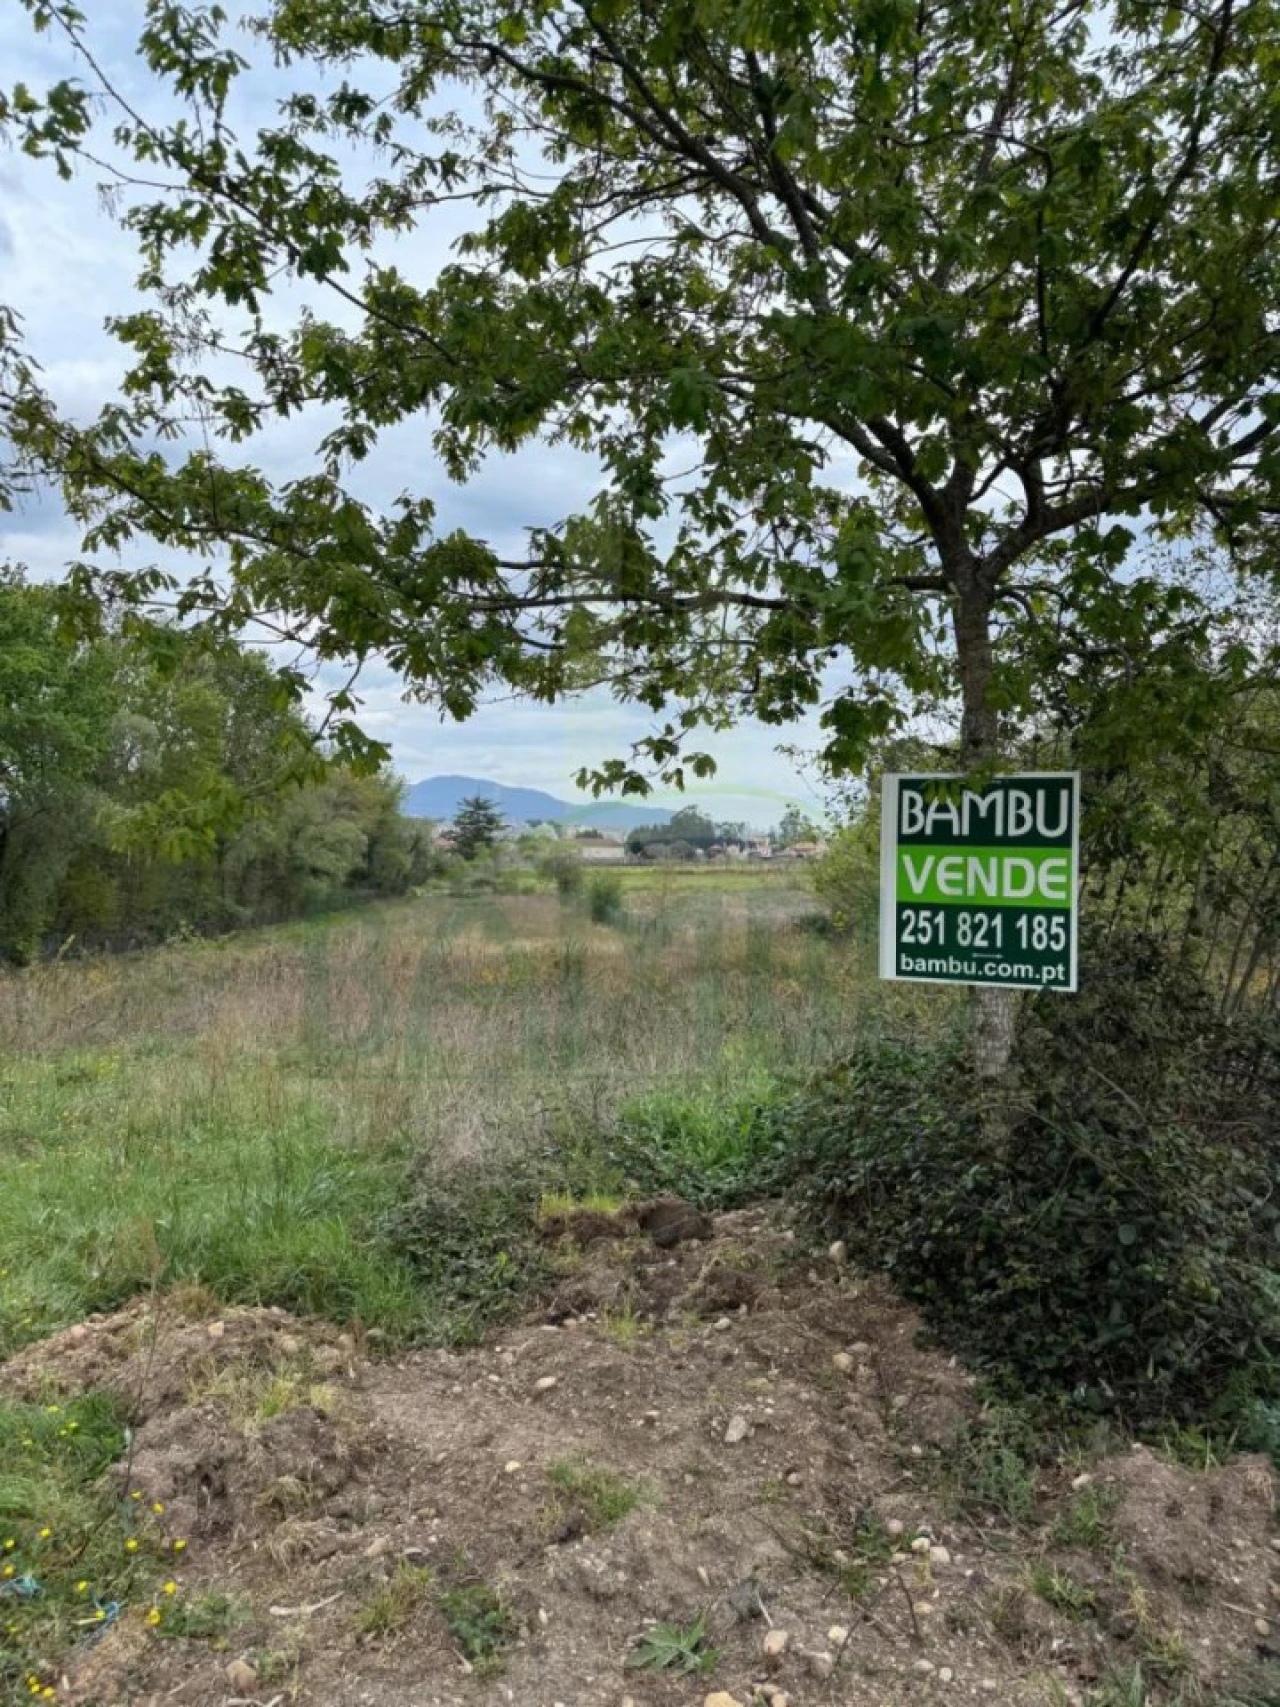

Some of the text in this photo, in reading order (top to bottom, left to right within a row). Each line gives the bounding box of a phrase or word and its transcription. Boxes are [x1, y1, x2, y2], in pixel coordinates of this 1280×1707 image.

[901, 788, 1069, 838] BAMBU
[902, 854, 1068, 899] VENDE
[900, 909, 1066, 951] 251 821 185
[900, 953, 1066, 983] bambu.com.pt
